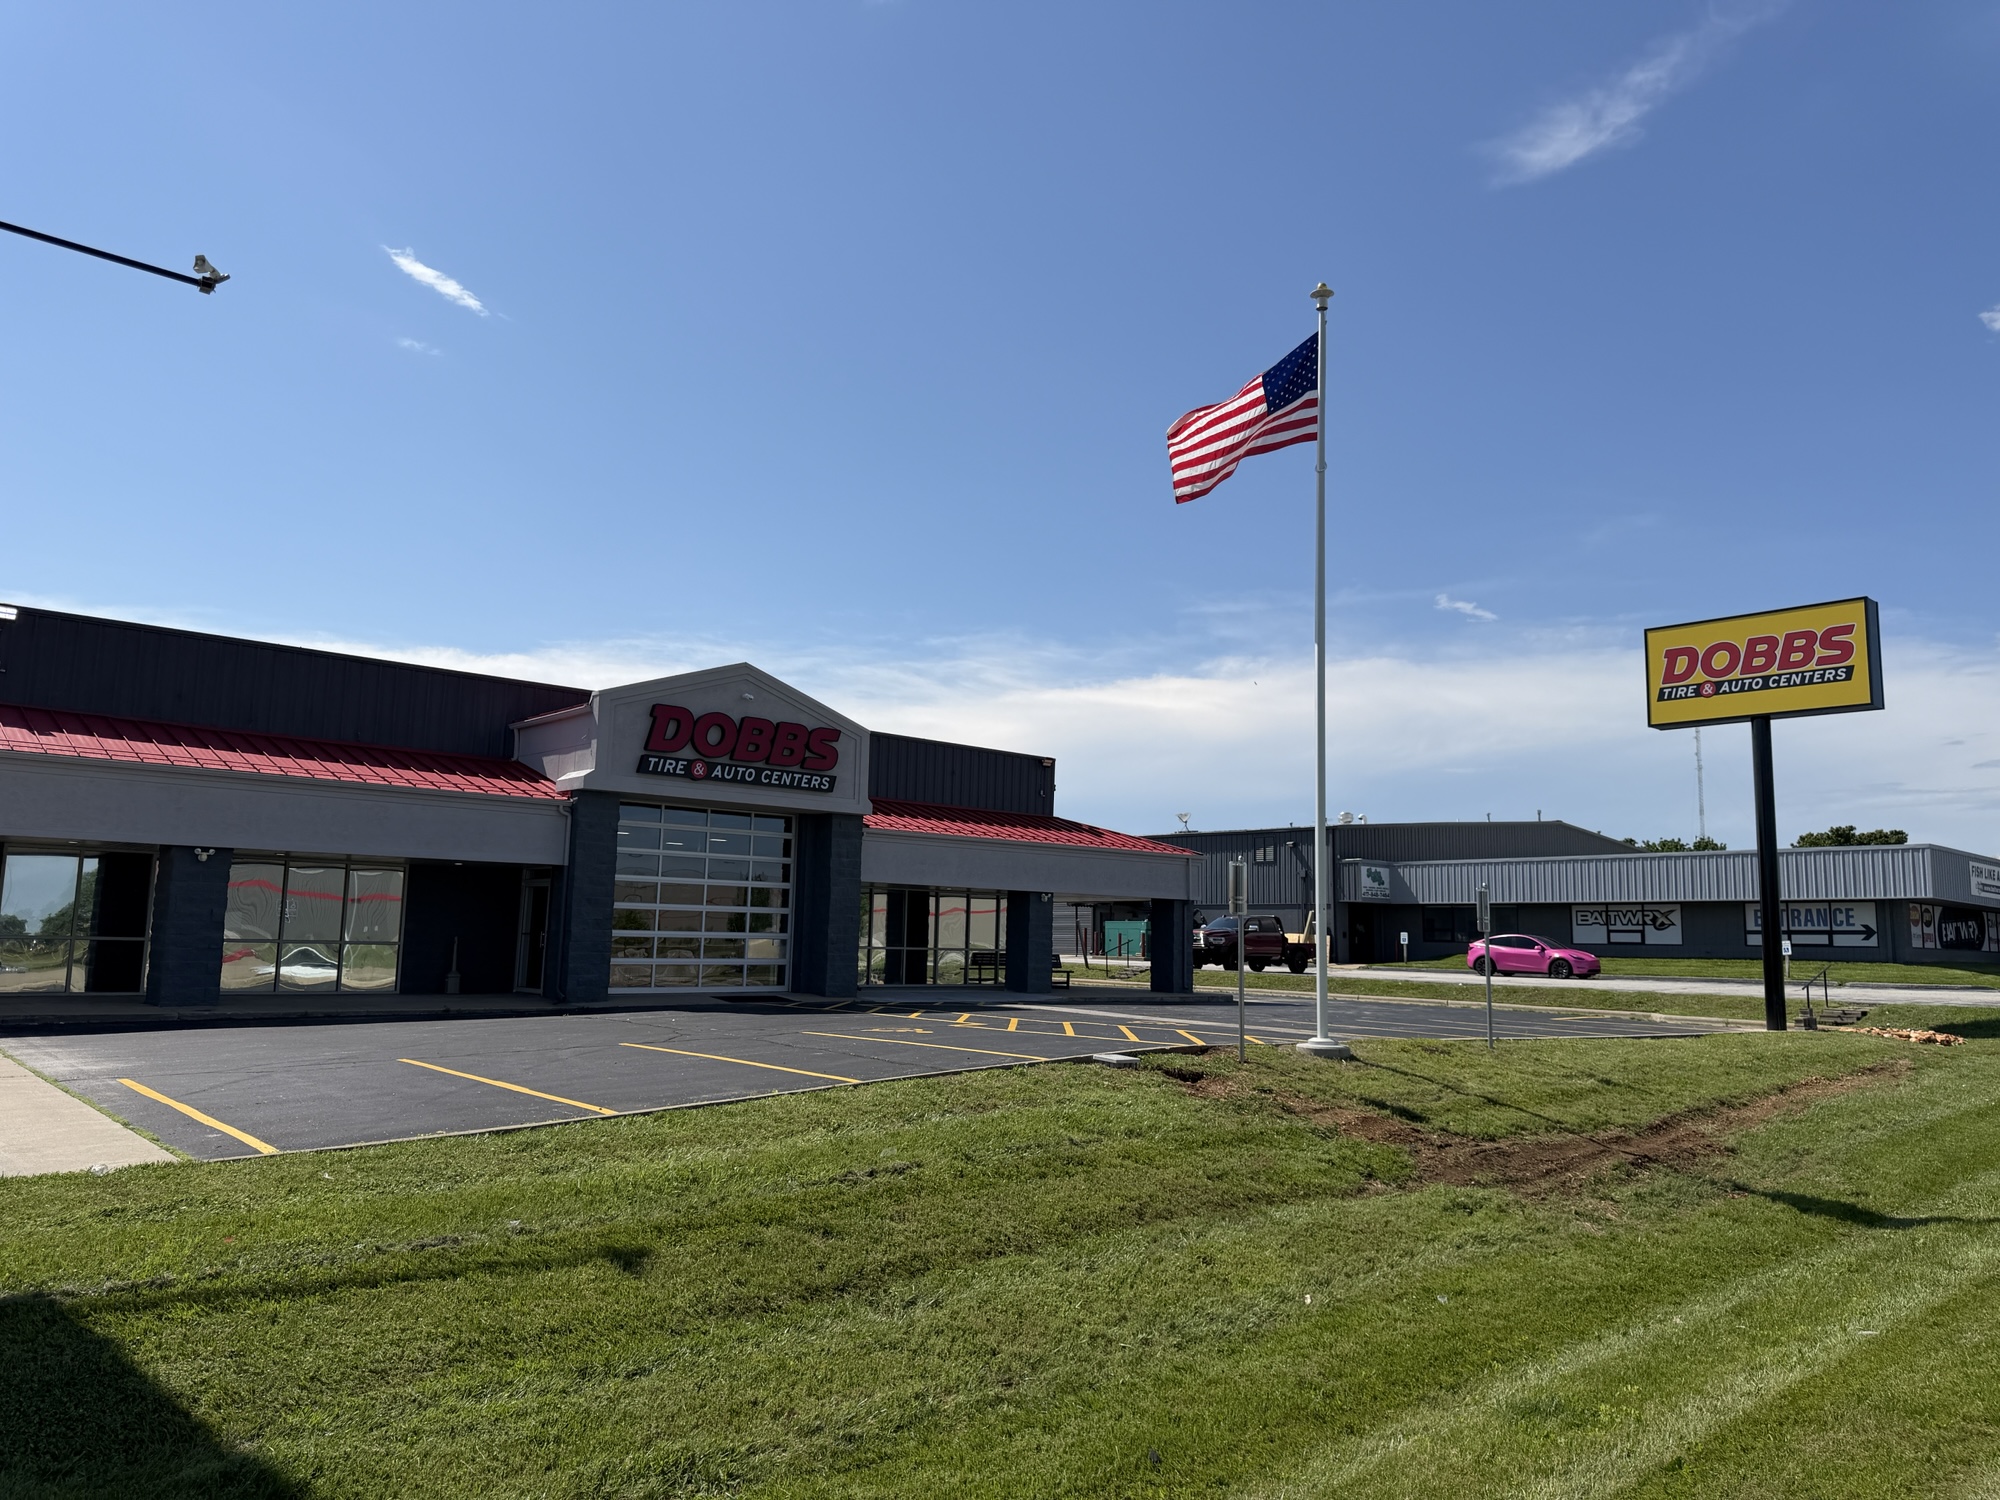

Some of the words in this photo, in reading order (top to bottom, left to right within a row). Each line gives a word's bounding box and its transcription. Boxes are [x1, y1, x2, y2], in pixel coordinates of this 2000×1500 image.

[1661, 622, 1856, 686] DOBBS
[1662, 685, 1697, 700] TIRE
[1702, 683, 1713, 695] &
[1719, 677, 1763, 694] AUTO
[1768, 668, 1847, 688] CENTERS
[644, 703, 841, 771] DOBBS
[648, 757, 687, 775] TIRE
[693, 762, 704, 776] &
[711, 767, 756, 782] AUTO
[761, 770, 830, 790] CENTERS
[1971, 865, 1984, 879] FISH
[1753, 907, 1856, 928] ETRANCE
